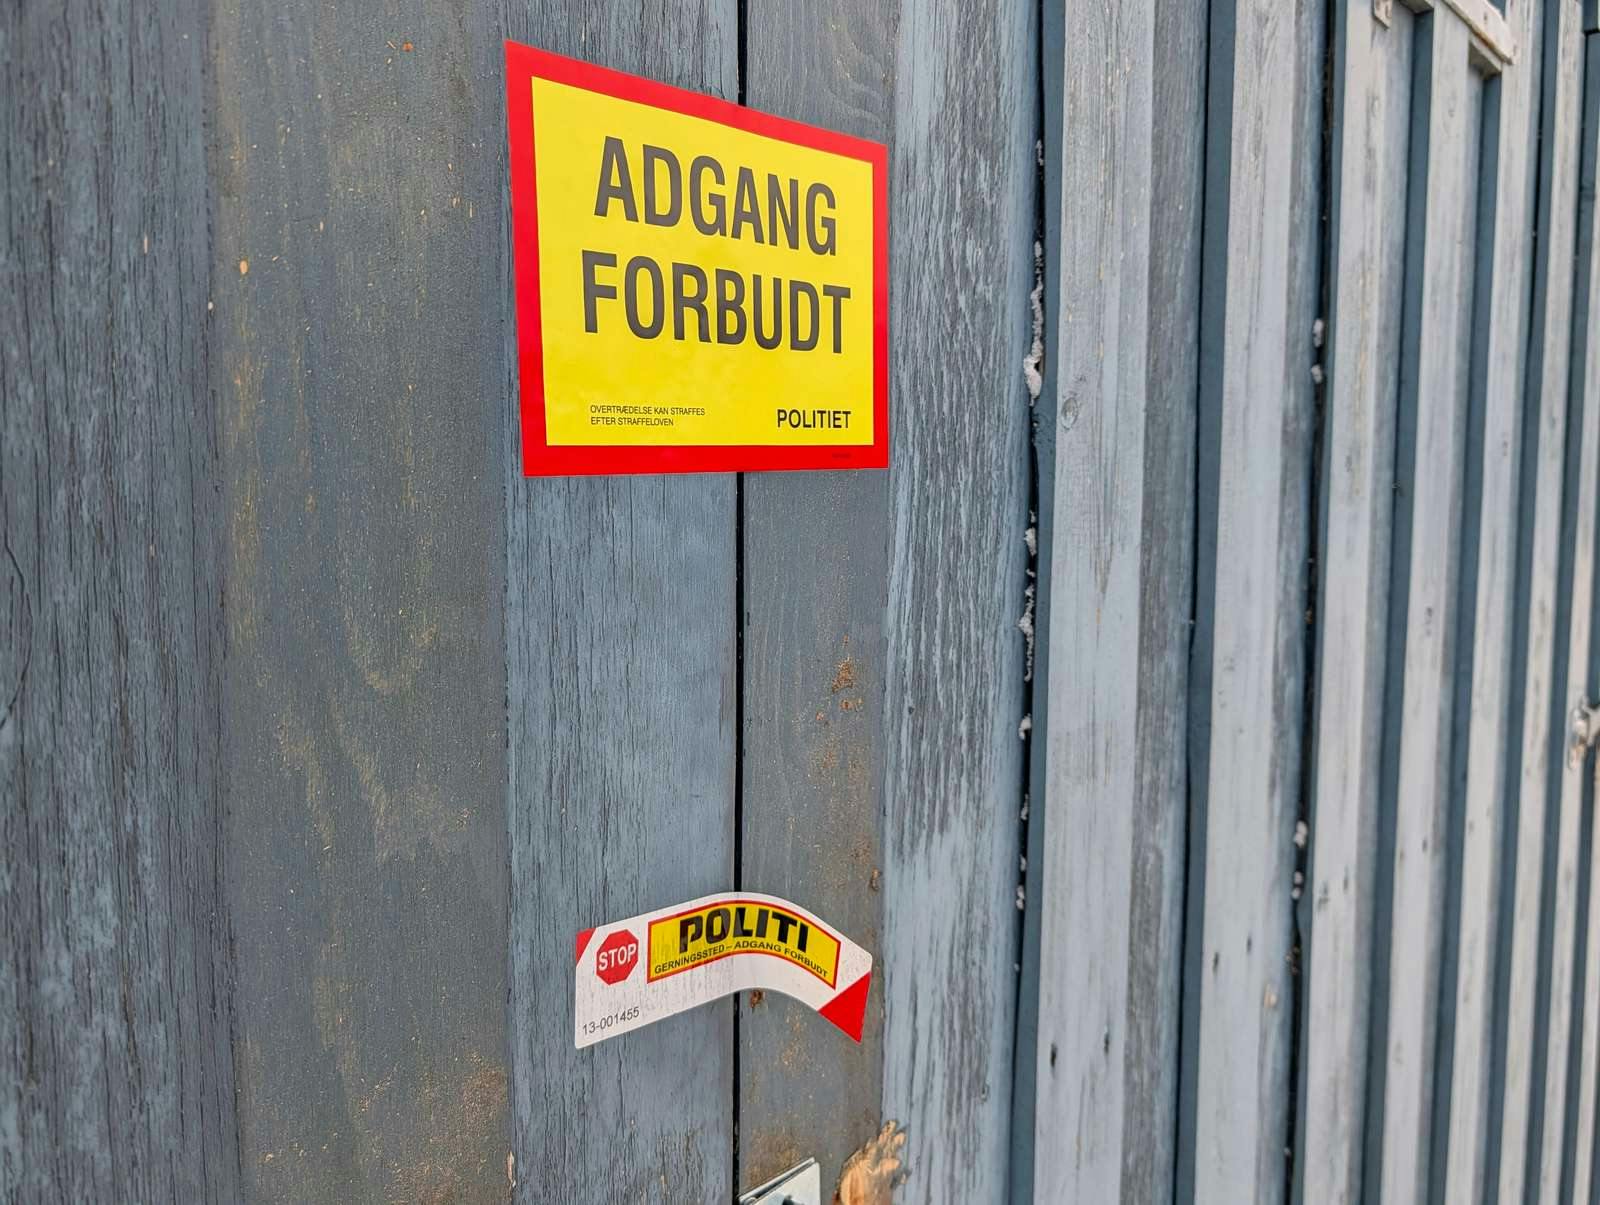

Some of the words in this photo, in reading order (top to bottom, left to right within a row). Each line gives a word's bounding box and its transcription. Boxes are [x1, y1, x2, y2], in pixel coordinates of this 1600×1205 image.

[594, 135, 837, 257] ADGANG
[581, 249, 852, 354] FORBUDT
[590, 405, 653, 415] OVERTRÆDELSE
[654, 406, 669, 415] KAN
[670, 407, 706, 416] STRAFFES
[591, 416, 616, 426] EFTER
[617, 417, 674, 426] STRAFFELOVEN
[777, 408, 852, 430] POLITIET
[679, 906, 809, 955] POLITI
[598, 943, 638, 972] STOP
[654, 944, 725, 975] GERNINGSSTED
[734, 940, 782, 953] ADGANG
[784, 948, 828, 979] FORBUDT
[582, 1006, 640, 1036] 13-001455
